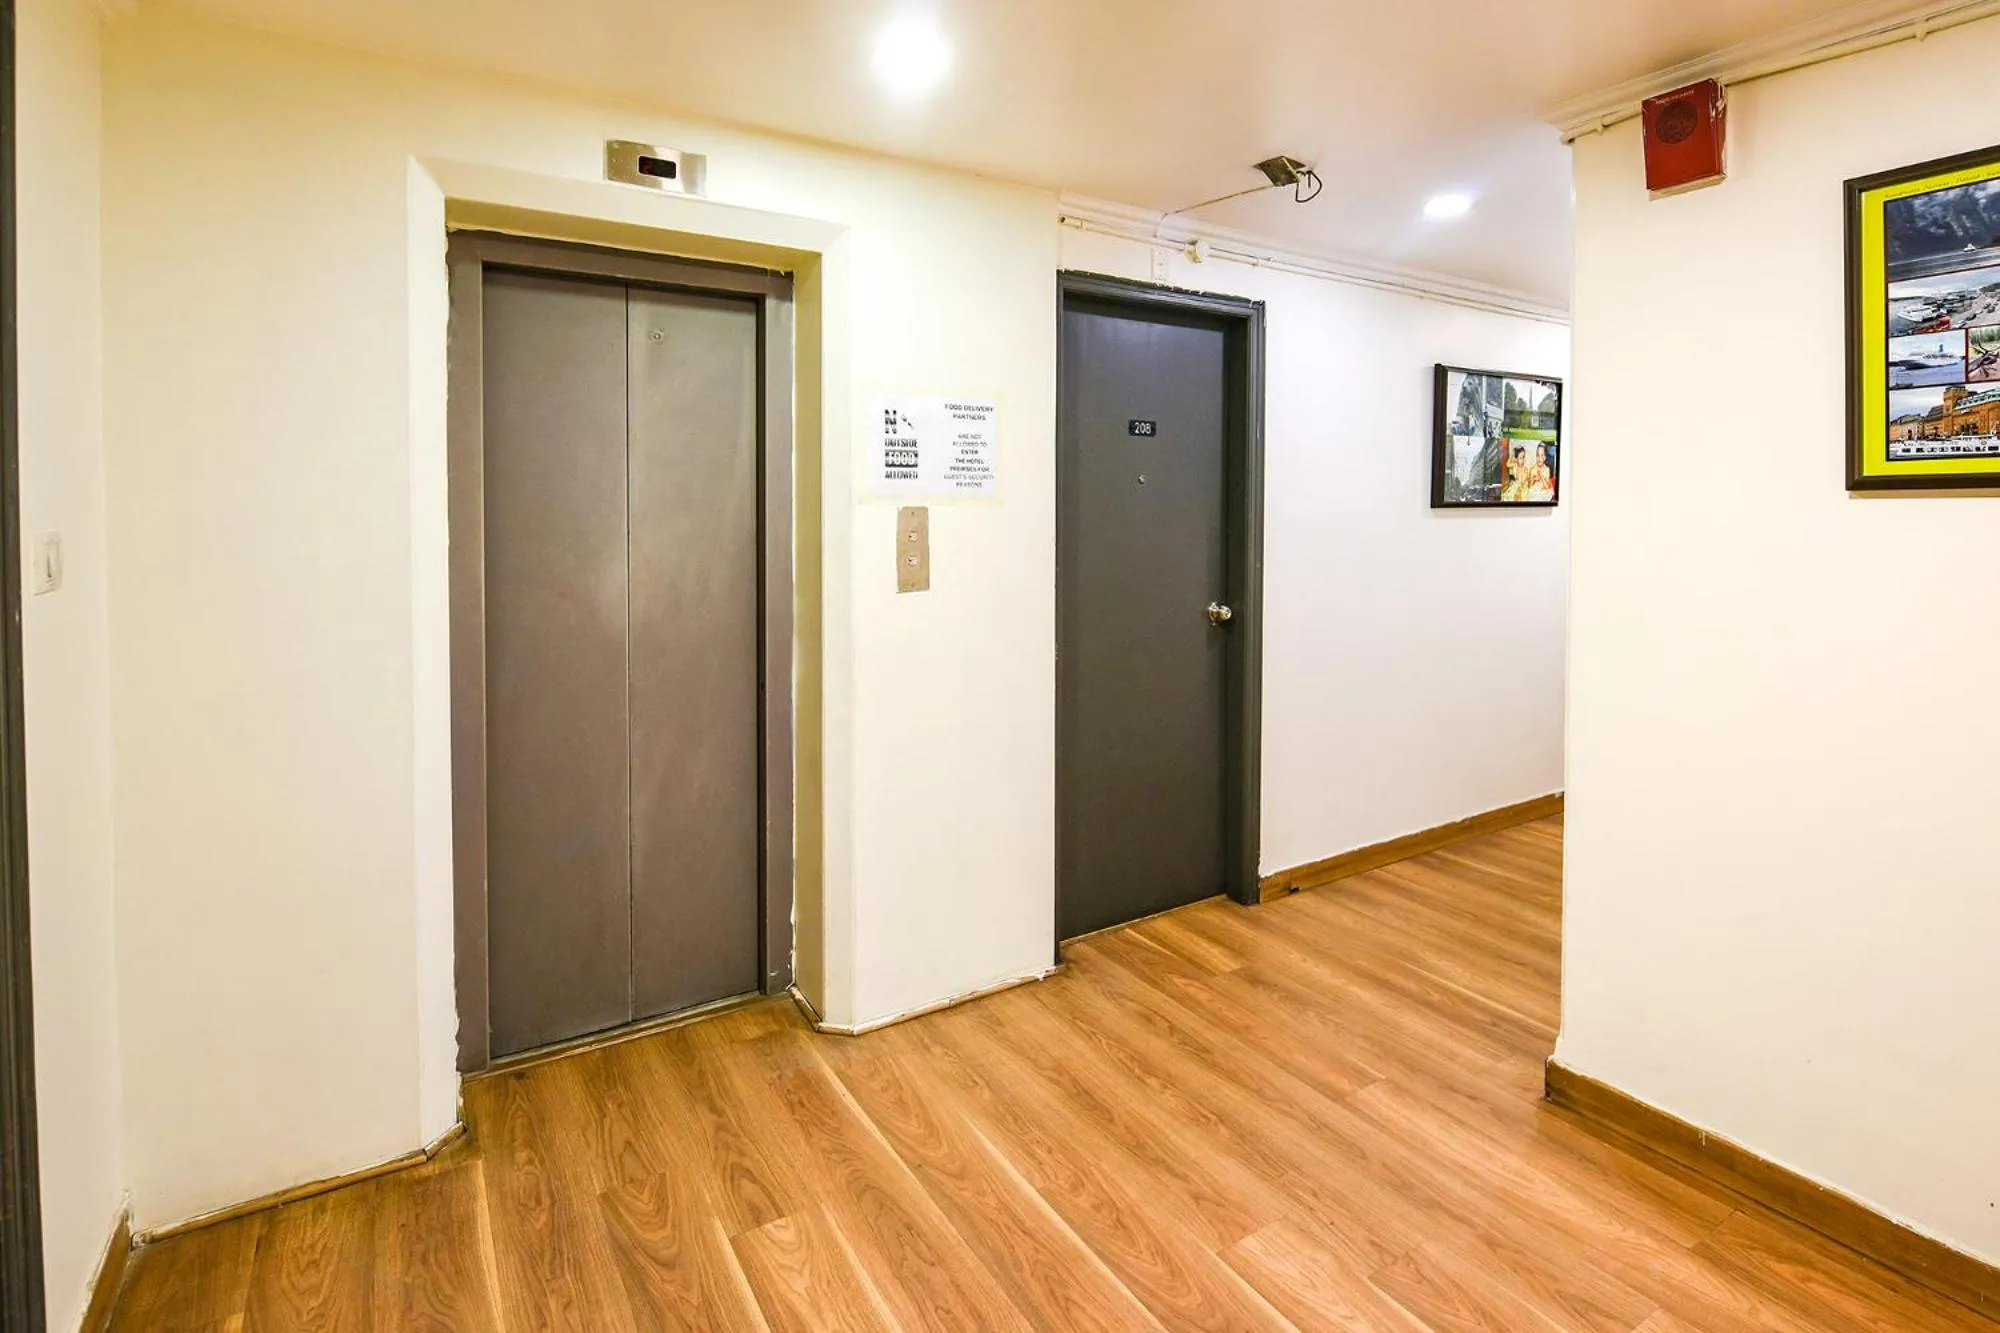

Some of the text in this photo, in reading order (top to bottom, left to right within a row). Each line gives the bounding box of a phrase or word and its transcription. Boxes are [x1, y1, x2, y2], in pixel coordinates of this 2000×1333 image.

[1135, 422, 1151, 434] 208
[884, 438, 918, 448] OUTSIDE
[888, 451, 915, 466] FOOD
[884, 470, 918, 480] ALLOWED
